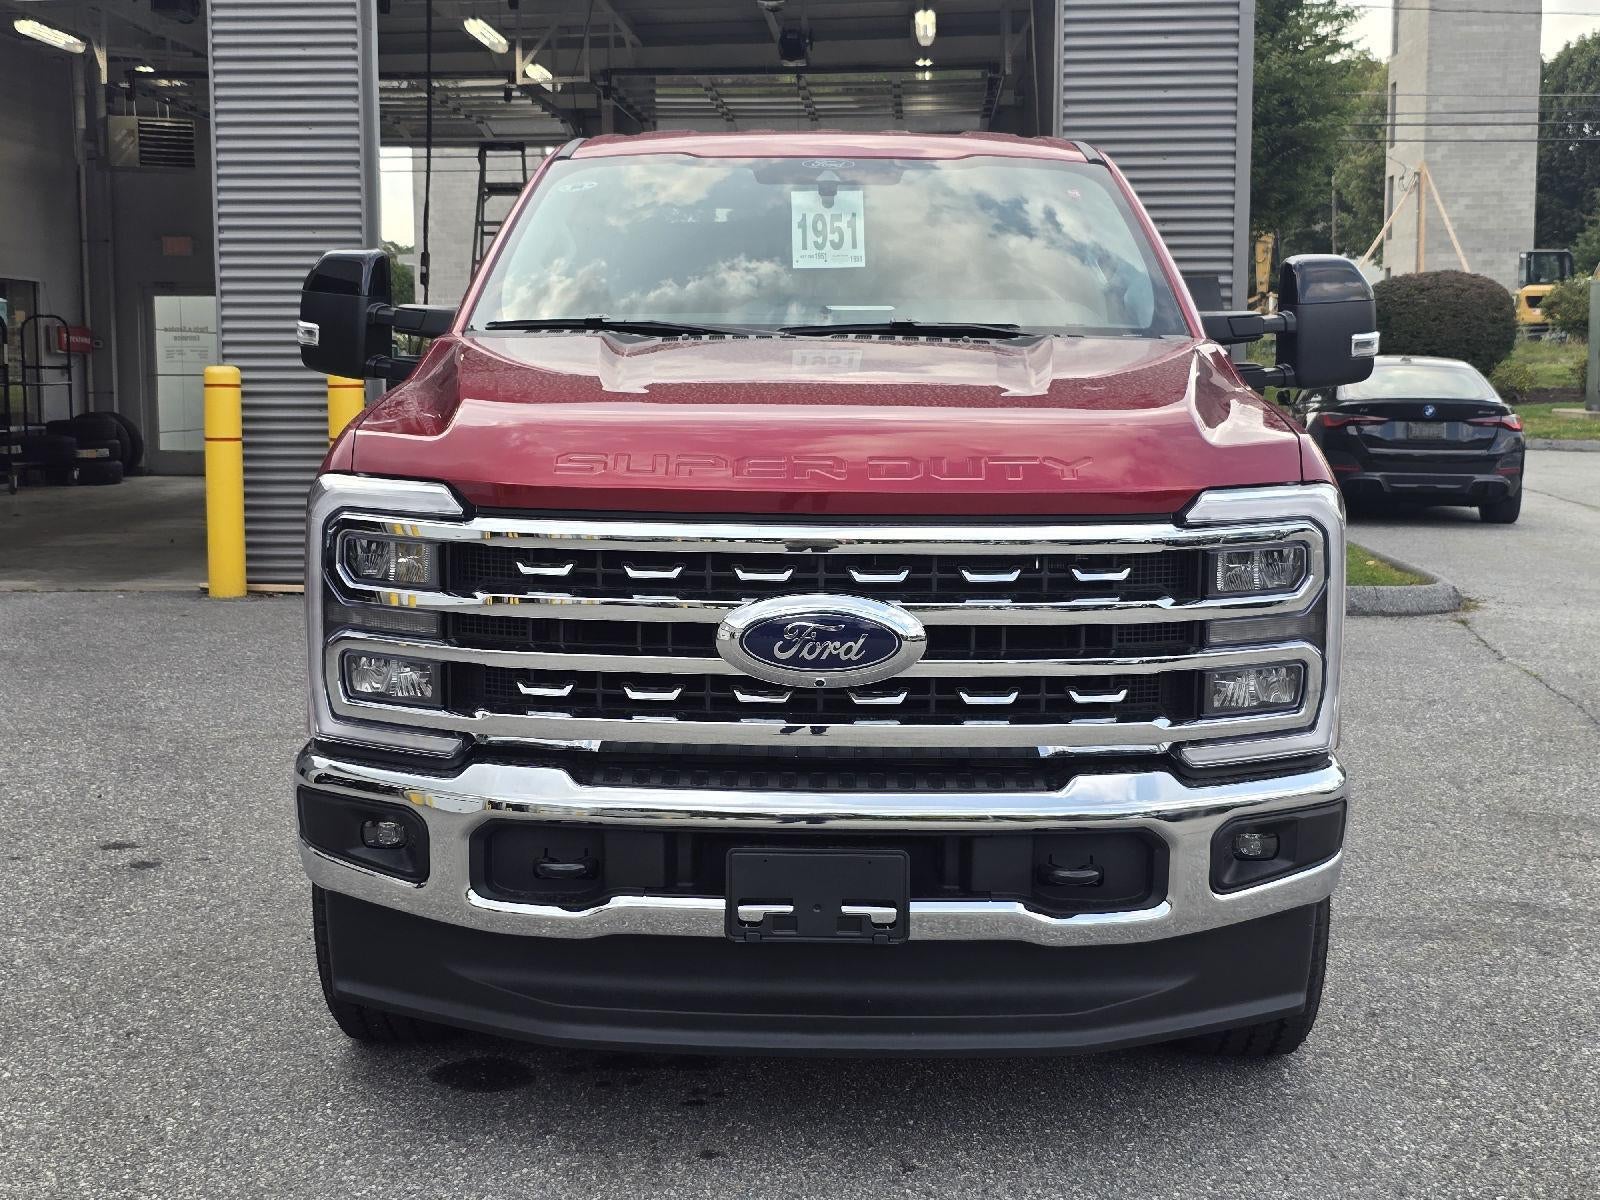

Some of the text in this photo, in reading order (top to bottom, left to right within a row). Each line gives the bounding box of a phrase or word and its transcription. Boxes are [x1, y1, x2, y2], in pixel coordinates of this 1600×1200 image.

[797, 212, 858, 250] 1951
[553, 452, 1093, 481] SUPER DUTY
[773, 621, 869, 661] Ford
